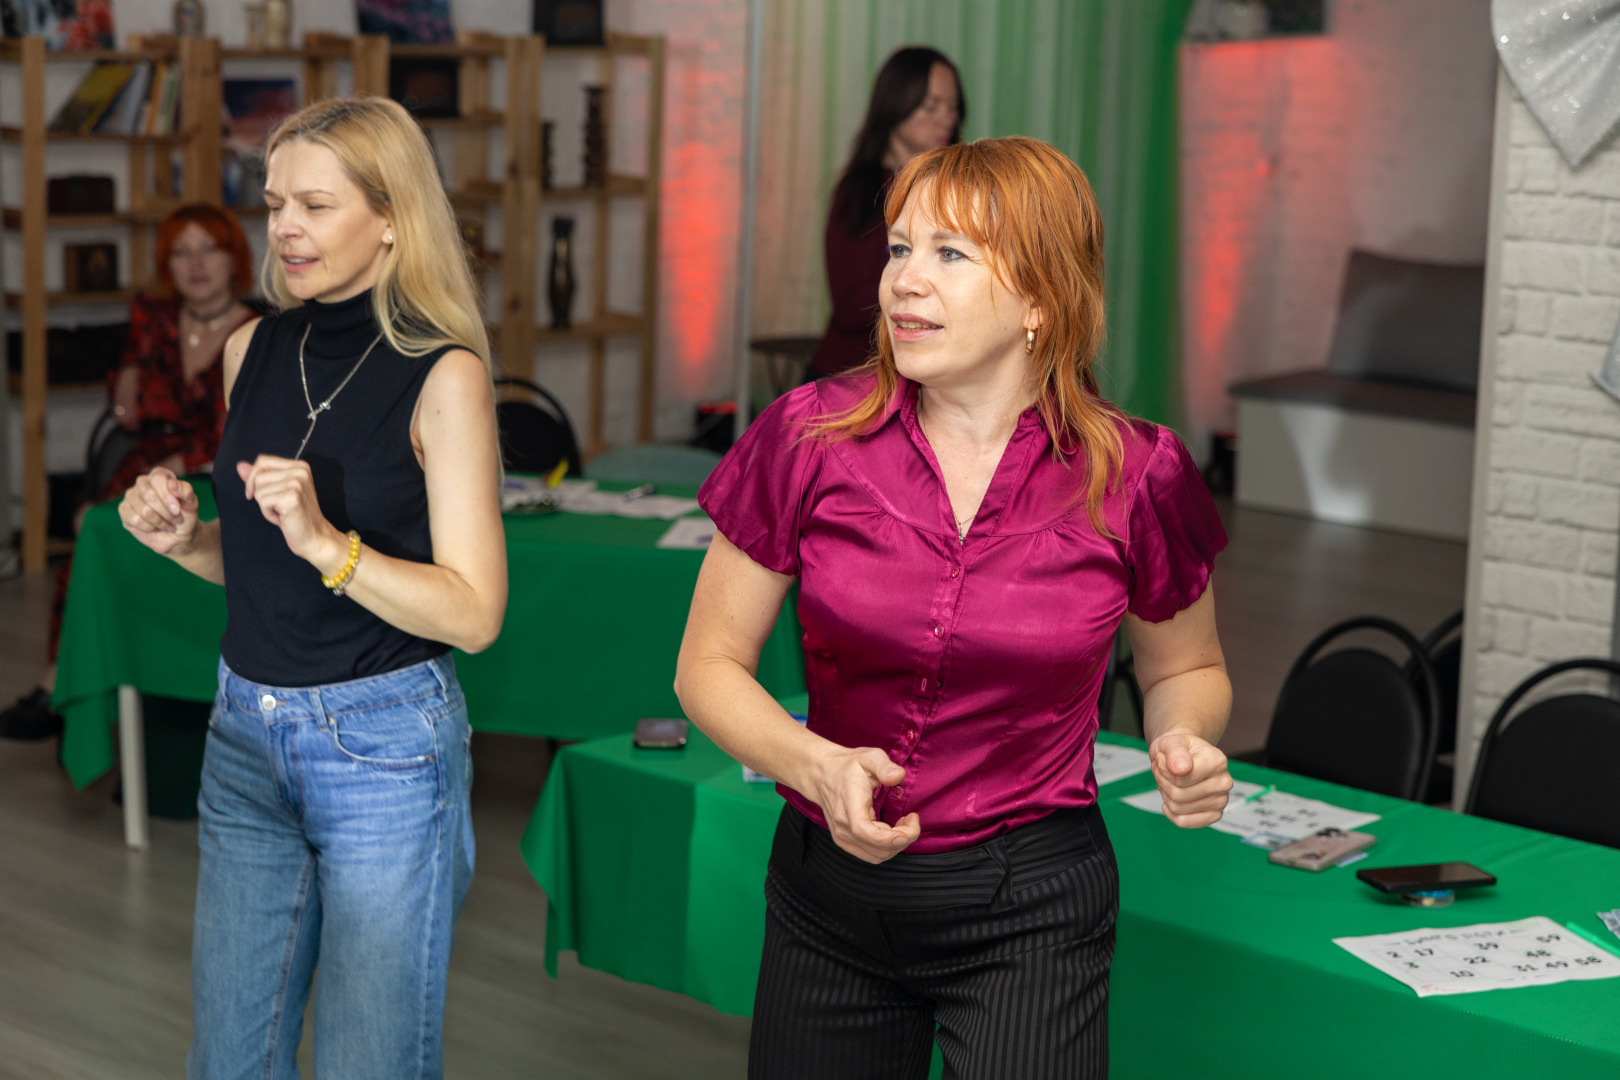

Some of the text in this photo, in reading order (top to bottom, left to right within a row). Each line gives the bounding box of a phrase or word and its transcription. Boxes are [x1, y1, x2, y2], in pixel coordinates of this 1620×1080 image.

[1414, 947, 1435, 957] 17
[1474, 941, 1499, 951] 39
[1535, 933, 1560, 943] 59
[1449, 955, 1602, 978] 10 31 49 58
[1463, 955, 1490, 965] 22
[1526, 949, 1552, 958] 48
